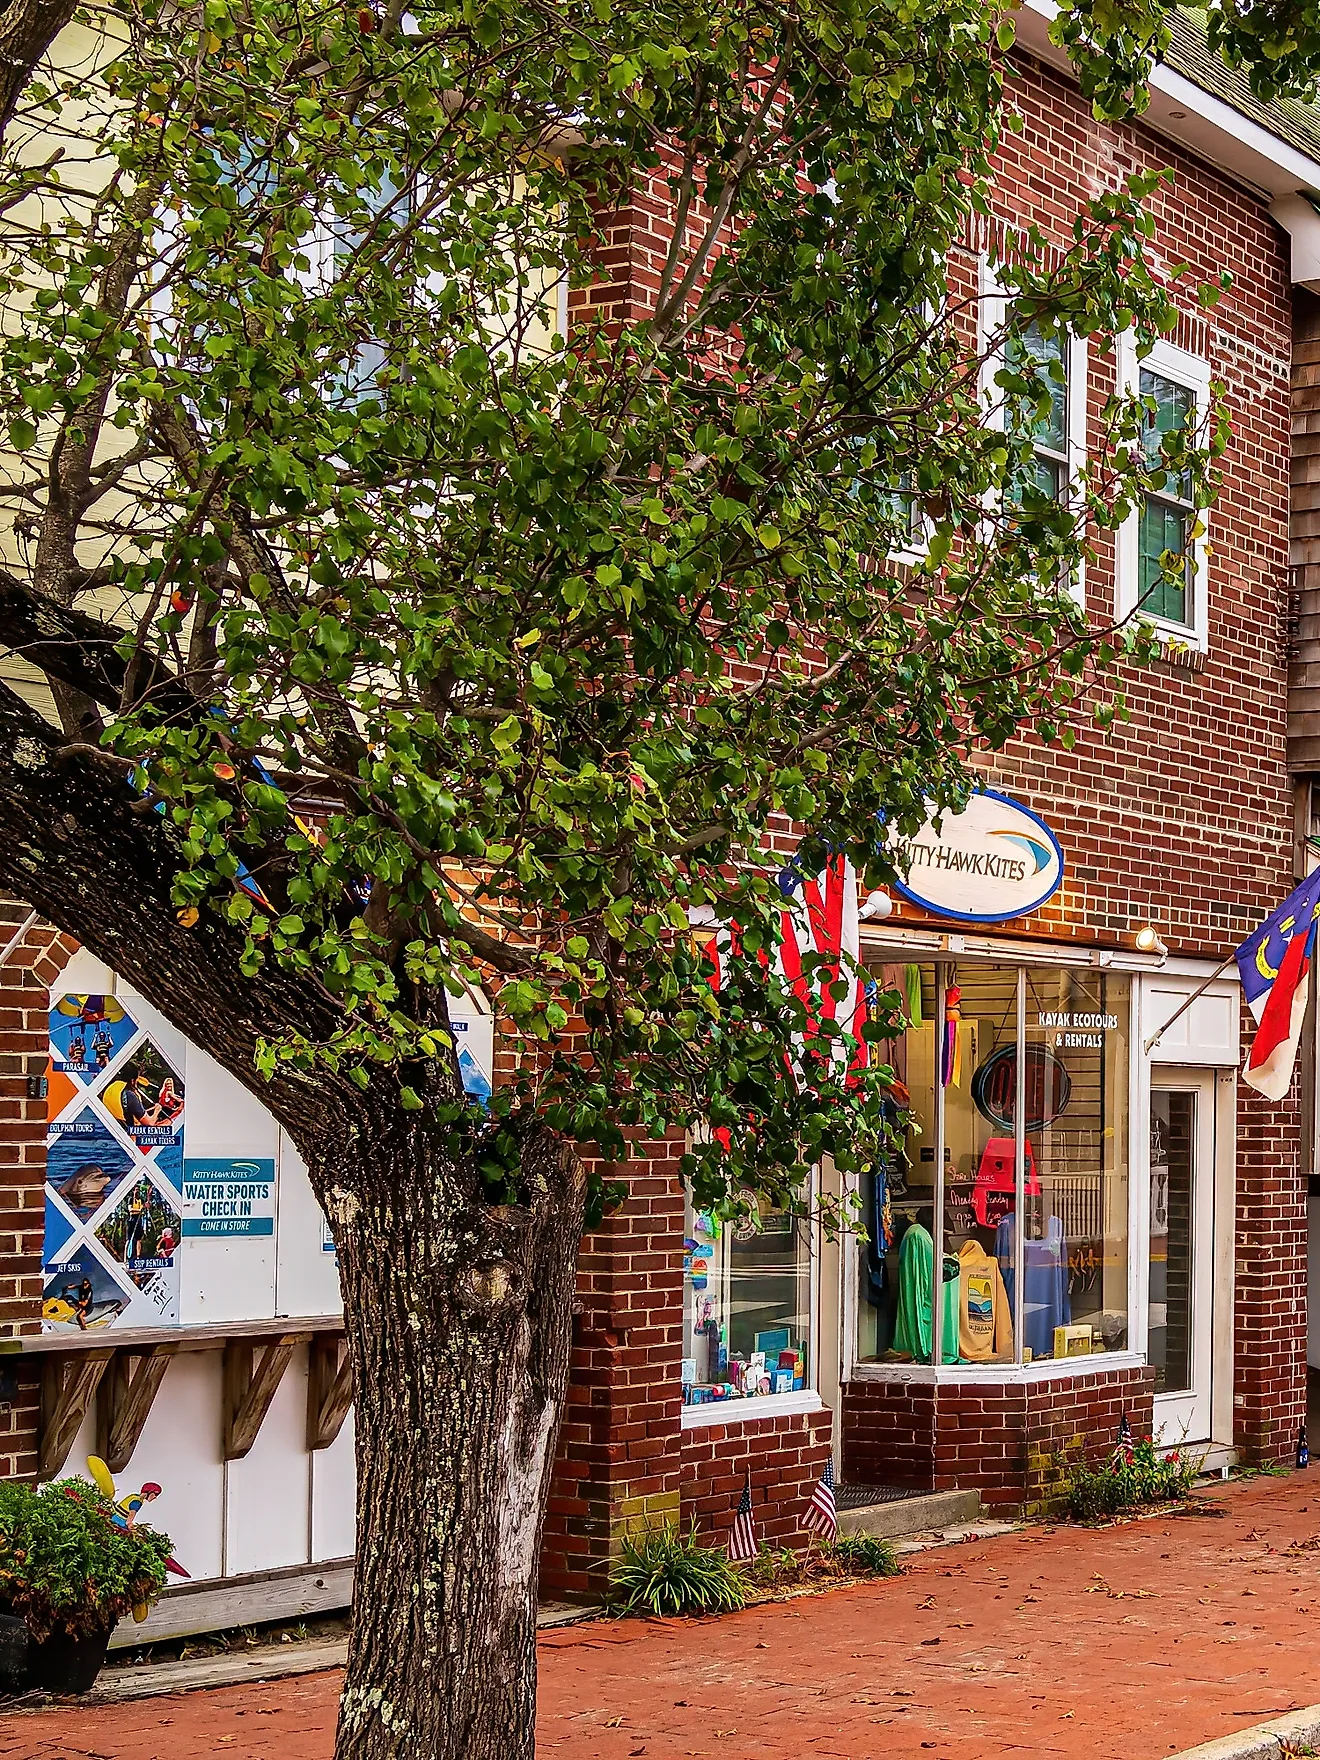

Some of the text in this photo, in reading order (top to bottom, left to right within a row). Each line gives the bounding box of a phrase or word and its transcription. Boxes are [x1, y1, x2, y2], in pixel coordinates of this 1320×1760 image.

[1038, 1011, 1119, 1029] KAYAK ECOTOURS
[1055, 1032, 1103, 1048] & RENTALS
[49, 1124, 75, 1133] DOLPHIN
[192, 1170, 211, 1179] KITTY
[230, 1170, 248, 1179] KITES
[185, 1184, 269, 1200] WATER SPORTS
[202, 1200, 252, 1216] CHECK IN
[200, 1220, 251, 1231] COME IN STORE
[57, 1263, 67, 1273] JET
[145, 1258, 169, 1268] RENTALS
